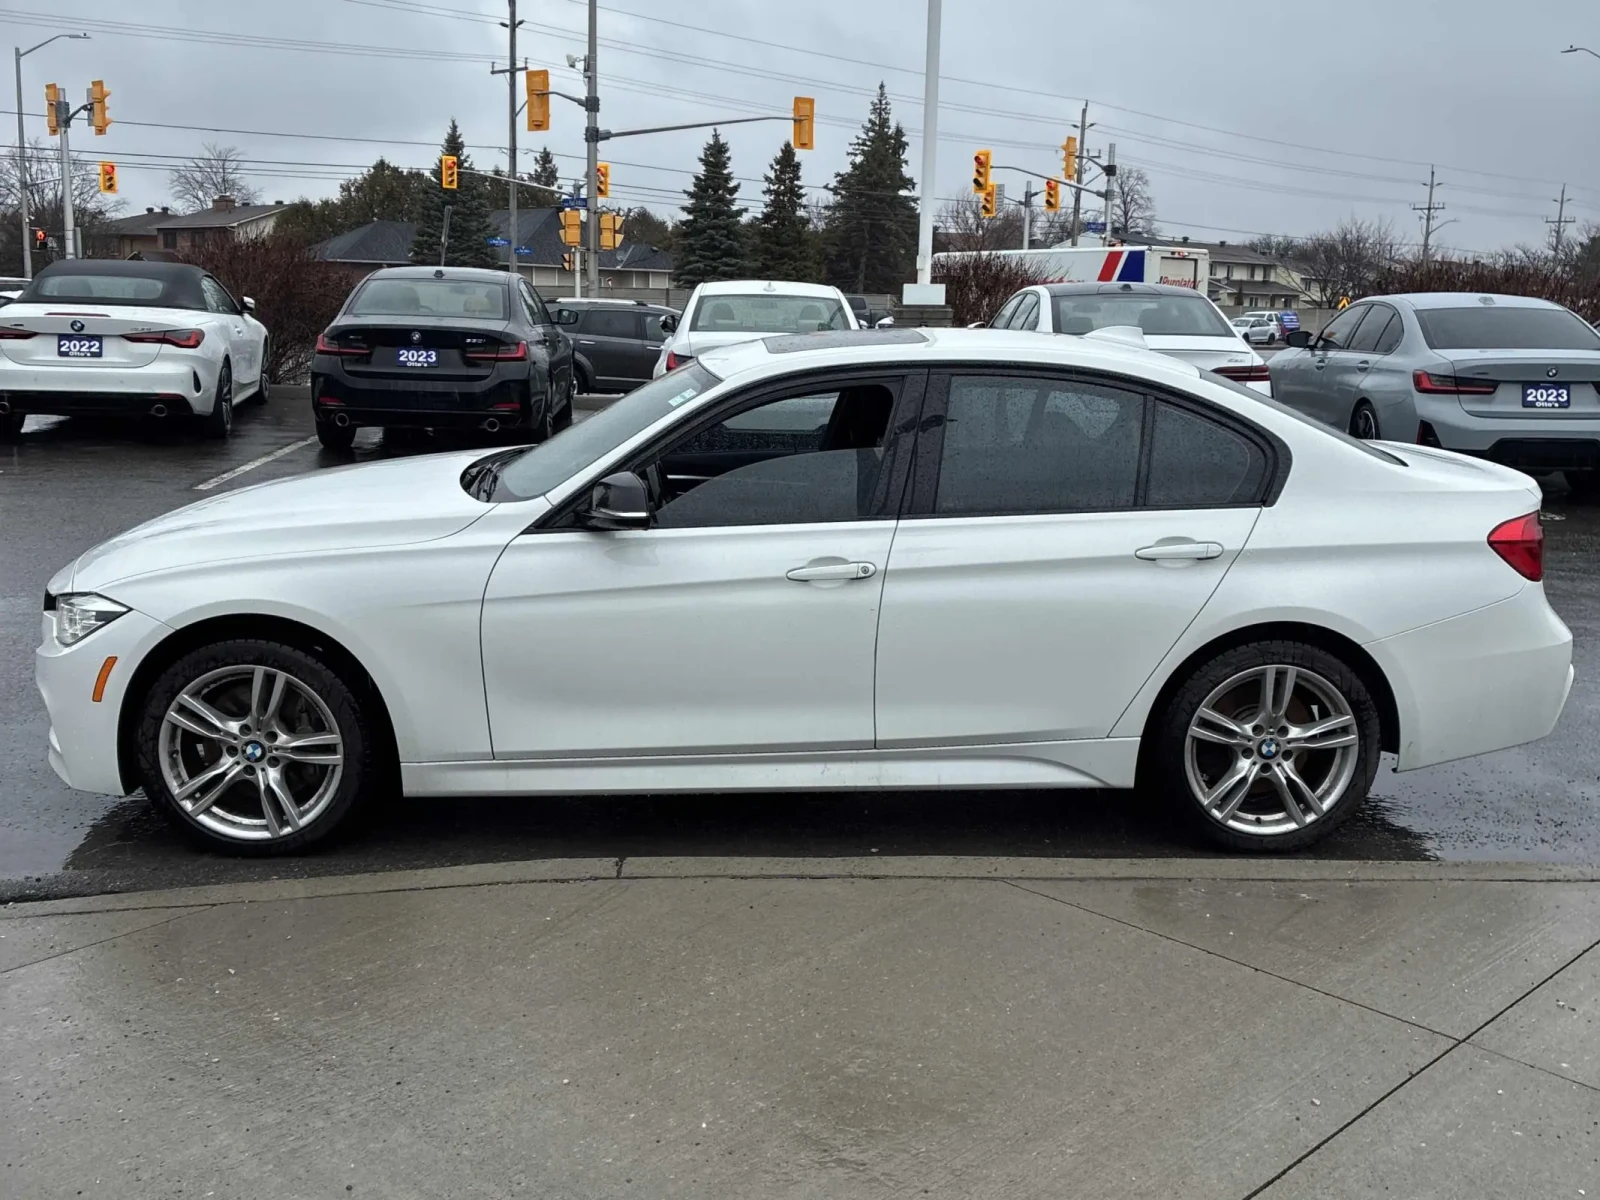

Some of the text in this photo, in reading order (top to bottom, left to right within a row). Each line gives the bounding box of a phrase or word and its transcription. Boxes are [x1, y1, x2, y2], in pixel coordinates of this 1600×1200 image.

[60, 340, 100, 352] 2022
[399, 350, 436, 362] 2023
[1527, 389, 1568, 401] 2023
